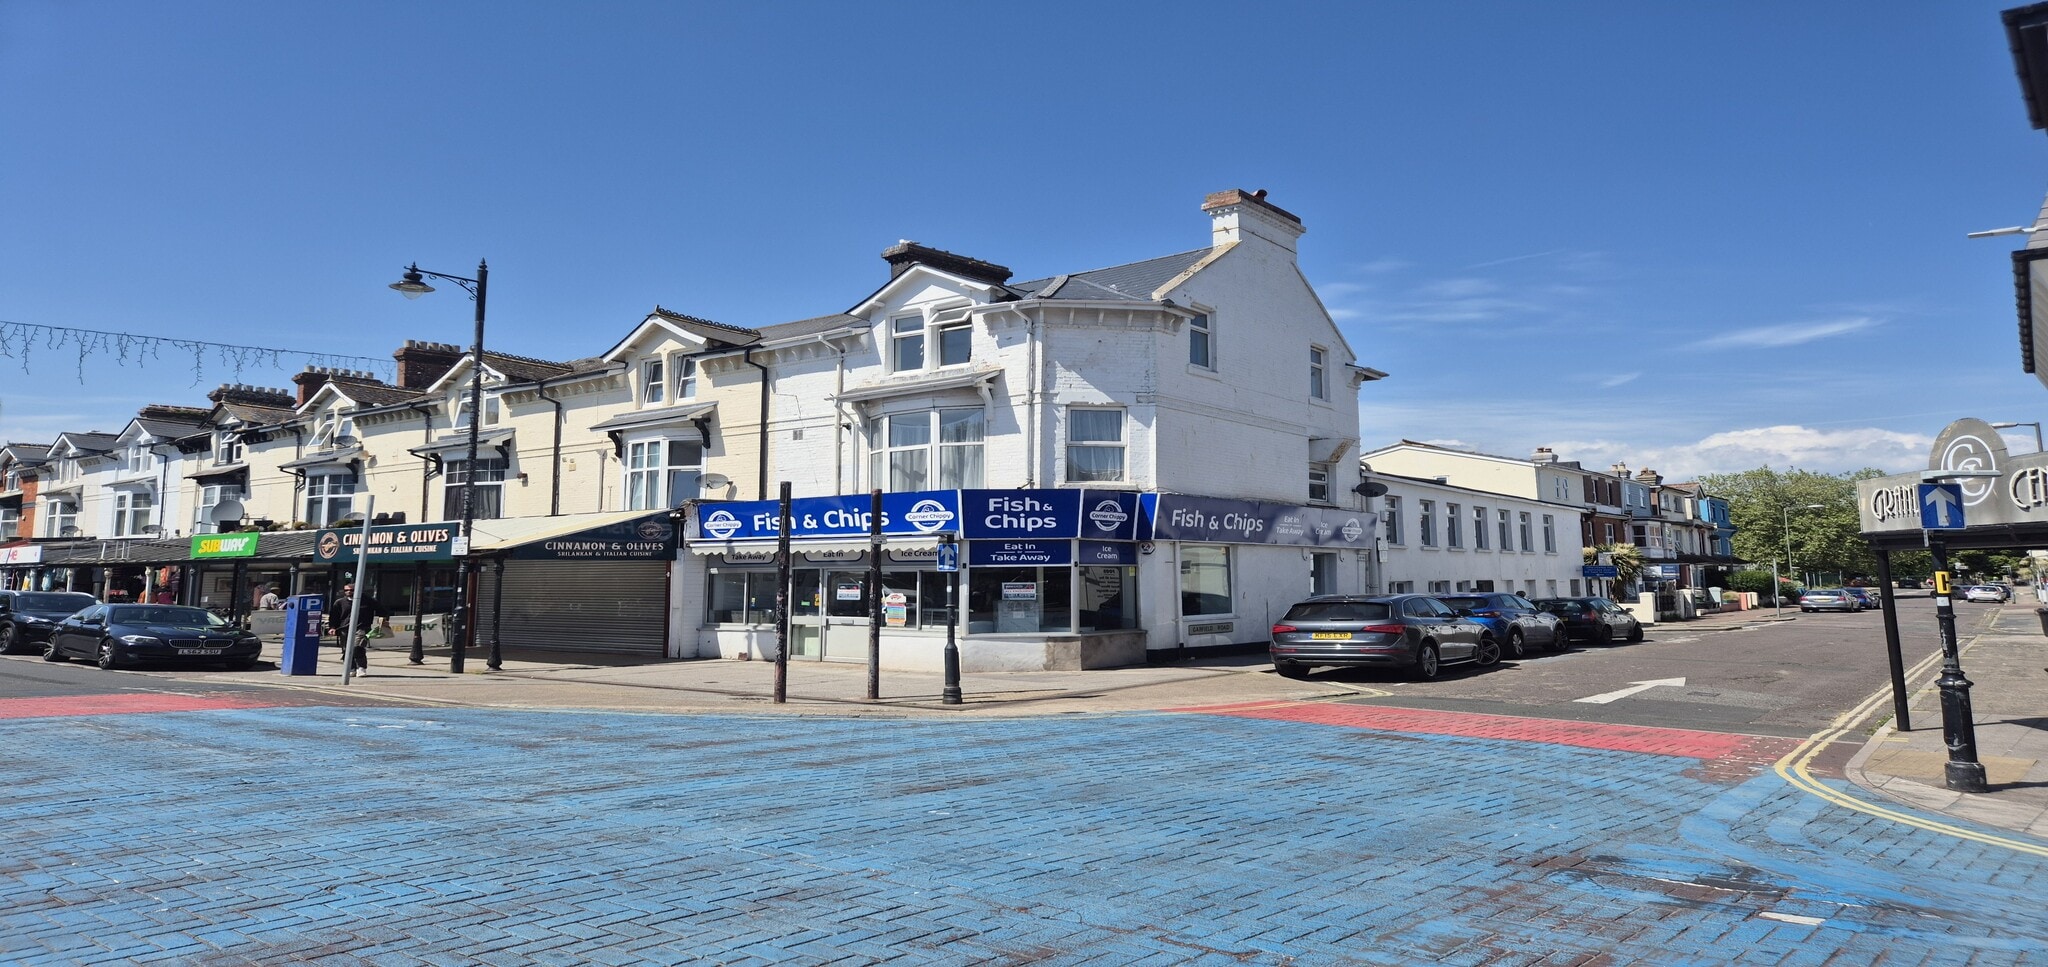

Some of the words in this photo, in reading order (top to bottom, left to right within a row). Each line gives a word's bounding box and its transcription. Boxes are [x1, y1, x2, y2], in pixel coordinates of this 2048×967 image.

[988, 497, 1040, 512] Fish
[1042, 503, 1053, 511] &
[803, 514, 818, 529] &
[824, 507, 890, 531] Chips
[930, 512, 951, 520] Chippy
[1284, 515, 1292, 523] Eat
[985, 513, 1057, 532] Chips
[1171, 508, 1204, 528] Fish
[1208, 515, 1219, 530] &
[1223, 513, 1264, 535] Chips
[396, 531, 407, 543] &
[410, 529, 448, 543] OLIVES
[1276, 527, 1290, 535] Take
[1290, 528, 1304, 536] Away
[198, 537, 249, 553] SUBWAY
[544, 542, 606, 551] CINNAMON
[611, 542, 621, 550] &
[626, 542, 664, 551] OLIVES
[747, 553, 766, 561] Away
[1019, 554, 1050, 562] Away
[1097, 552, 1118, 560] Cream
[306, 599, 320, 610] P
